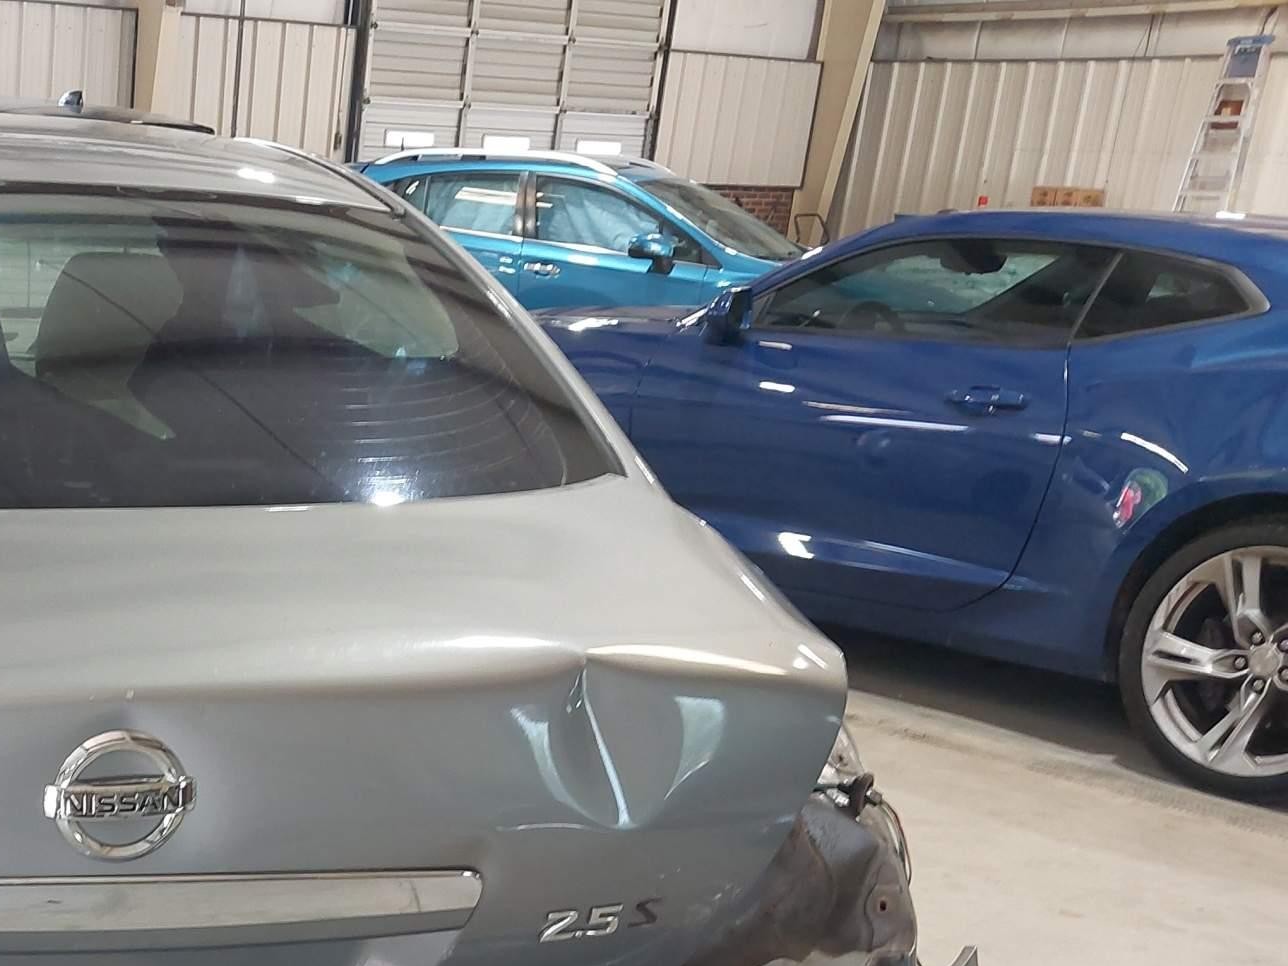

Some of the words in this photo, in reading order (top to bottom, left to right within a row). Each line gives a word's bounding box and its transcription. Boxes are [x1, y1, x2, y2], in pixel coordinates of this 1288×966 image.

[64, 784, 183, 817] NISSAN
[538, 903, 624, 943] 2.5
[627, 896, 665, 929] S
